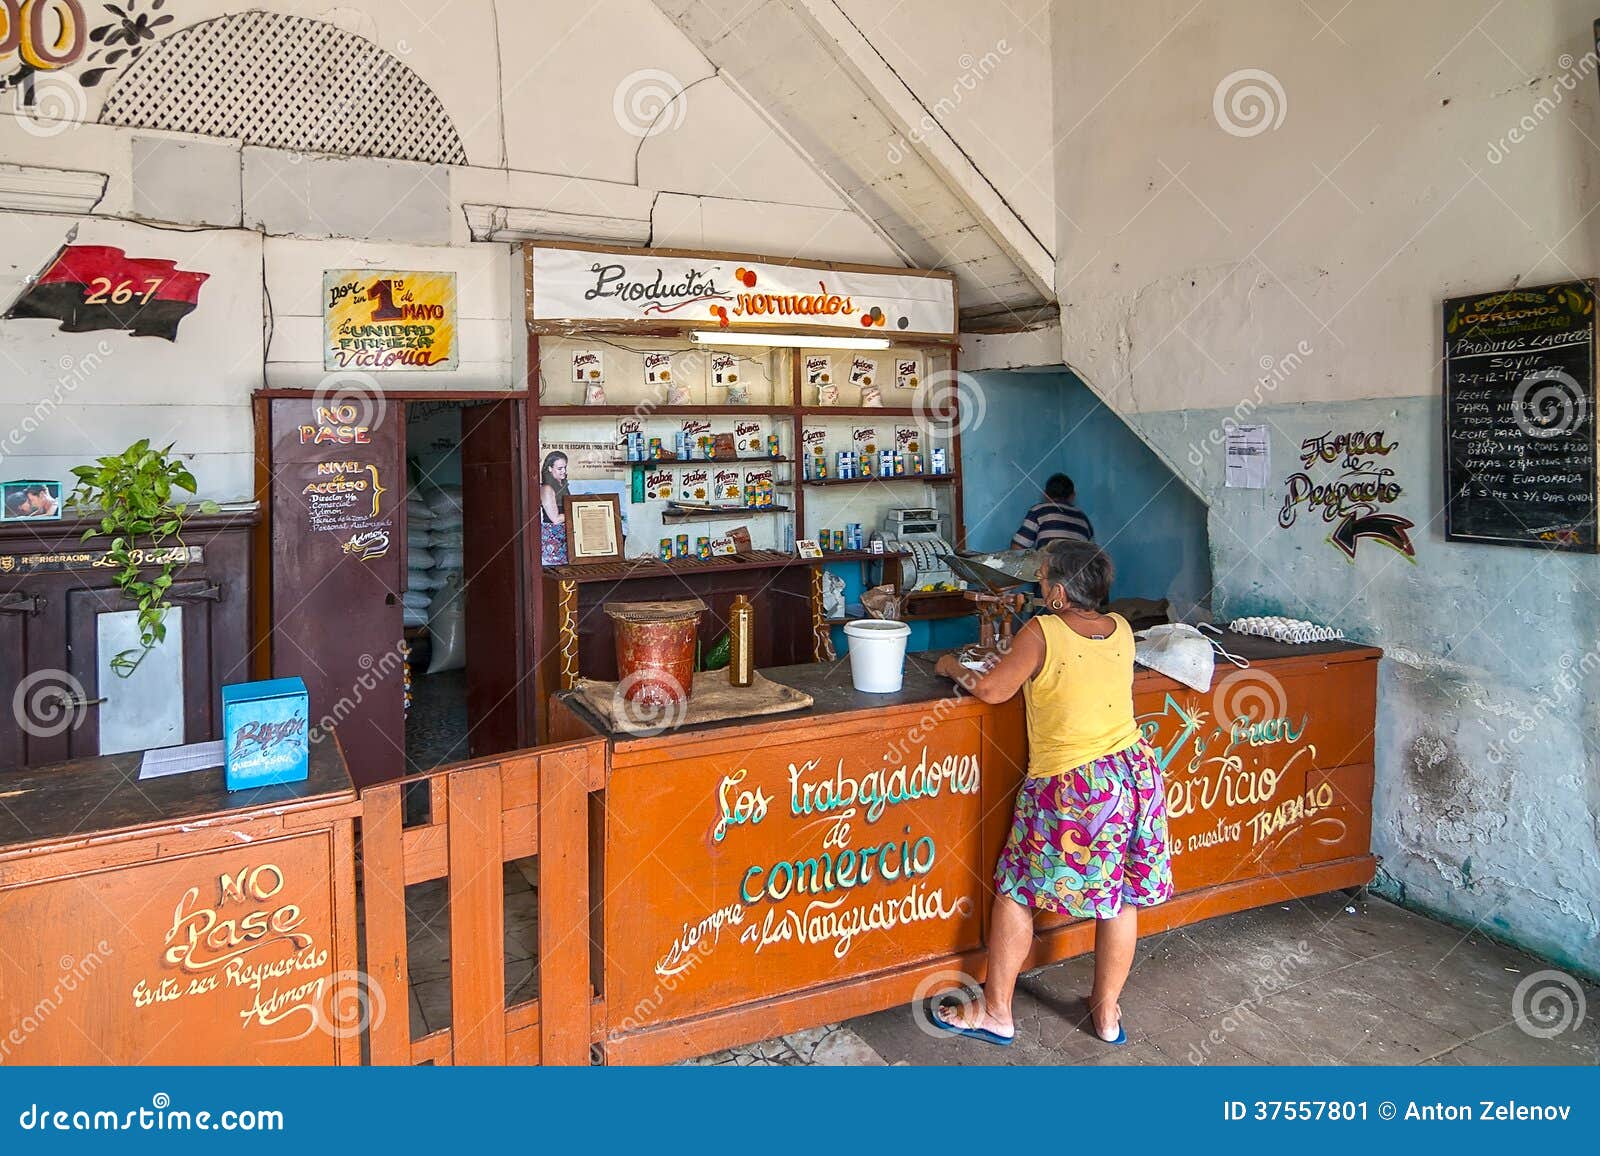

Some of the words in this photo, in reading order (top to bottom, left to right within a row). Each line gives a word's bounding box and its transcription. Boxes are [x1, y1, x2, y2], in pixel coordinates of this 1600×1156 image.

[85, 277, 163, 306] 26-7
[584, 262, 732, 302] Productos
[402, 304, 445, 321] MAYO
[339, 335, 435, 350] FIRMEZA
[351, 324, 435, 337] UNIDAD
[331, 347, 450, 368] Victoria
[1456, 390, 1492, 400] LECHE
[1456, 402, 1489, 413] PARA
[316, 404, 358, 426] NO
[298, 424, 372, 445] PASE
[317, 460, 364, 475] NIVEL
[302, 480, 369, 495] ACCESO
[1165, 748, 1308, 818] ervicio
[712, 767, 775, 843] Los
[1246, 782, 1334, 846] TRABAJO
[822, 807, 857, 850] de
[738, 825, 936, 905] comercio
[216, 863, 285, 908] NO
[164, 886, 313, 969] Pase
[654, 903, 746, 976] siempre
[788, 881, 974, 959] Vanguardia
[185, 974, 223, 996] ser
[223, 948, 329, 991] Requerido
